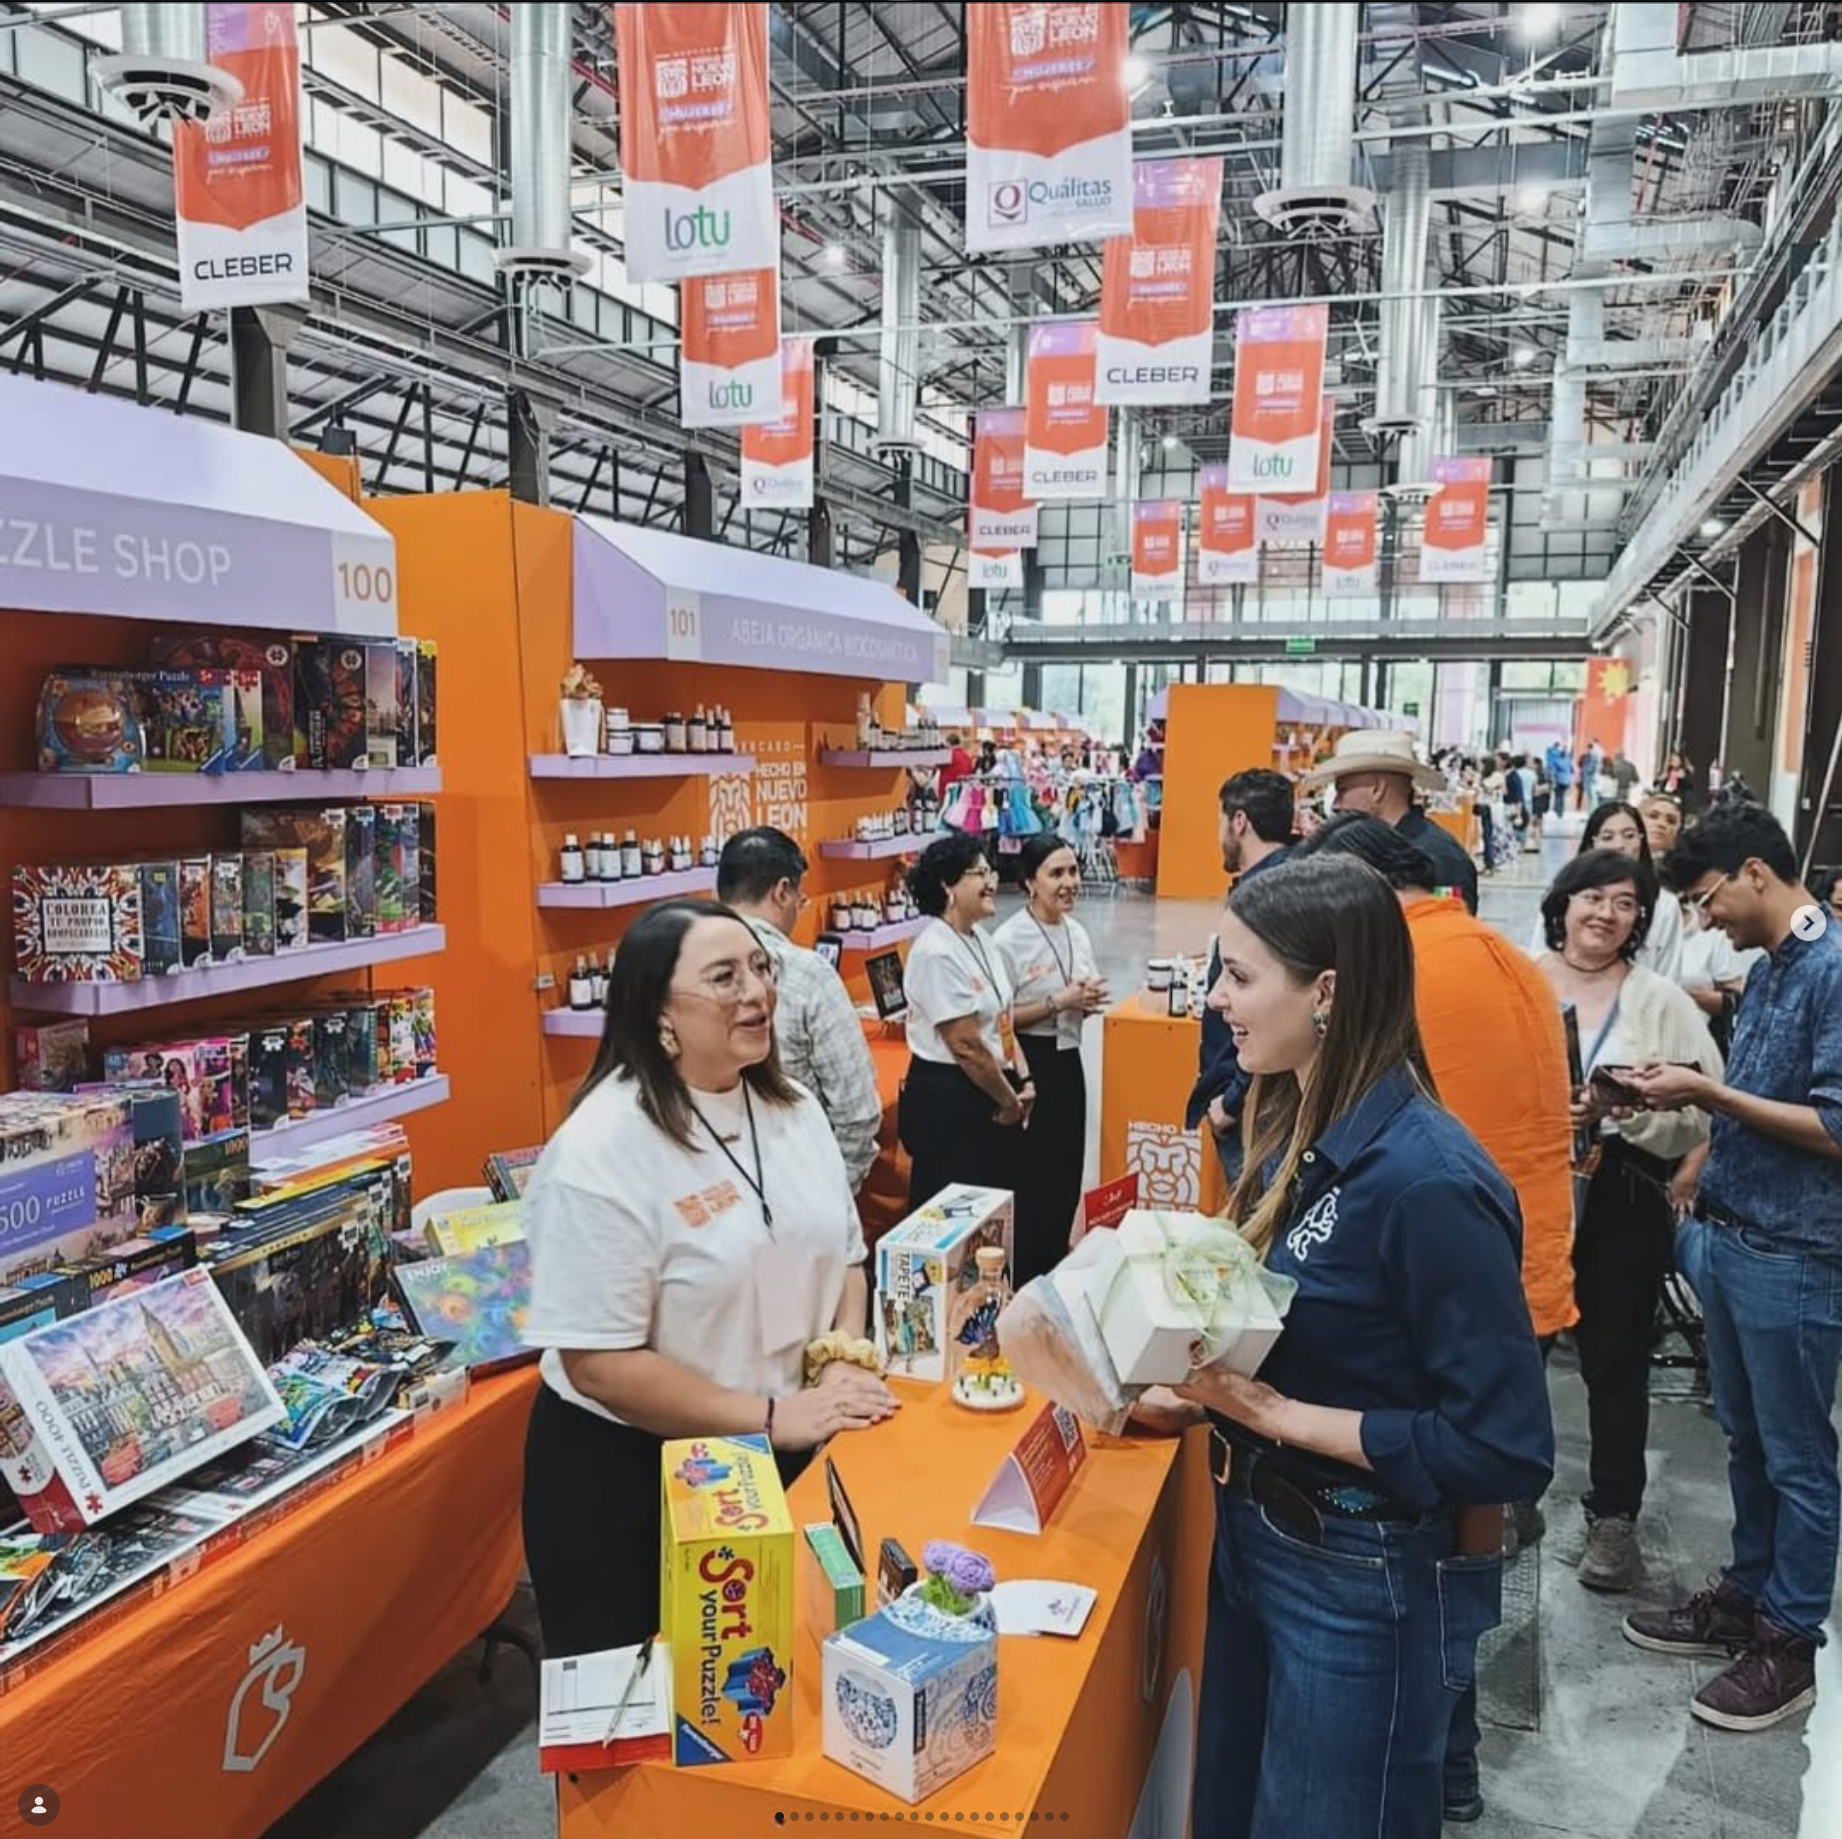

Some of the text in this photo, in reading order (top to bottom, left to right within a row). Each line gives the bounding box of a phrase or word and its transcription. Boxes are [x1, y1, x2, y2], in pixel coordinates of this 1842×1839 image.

[1028, 177, 1112, 205] Quálitas
[664, 204, 730, 251] lotu
[193, 252, 293, 281] CLEBER
[1107, 366, 1199, 384] CLEBER
[709, 379, 753, 410] lotu
[1032, 470, 1098, 483] CLEBER
[1253, 453, 1293, 478] lotu
[979, 525, 1031, 536] CLEBER
[114, 533, 231, 587] SHOP
[339, 561, 392, 604] 100
[669, 608, 697, 638] 101
[757, 779, 807, 801] NUEVO
[46, 903, 107, 916] COLOREA
[1127, 1120, 1179, 1135] HECHO
[89, 1268, 113, 1289] 1000
[406, 1261, 450, 1280] ENJOY
[898, 1251, 911, 1300] TAPETE
[699, 1549, 755, 1641] Sort
[699, 1589, 722, 1726] your Puzzle!
